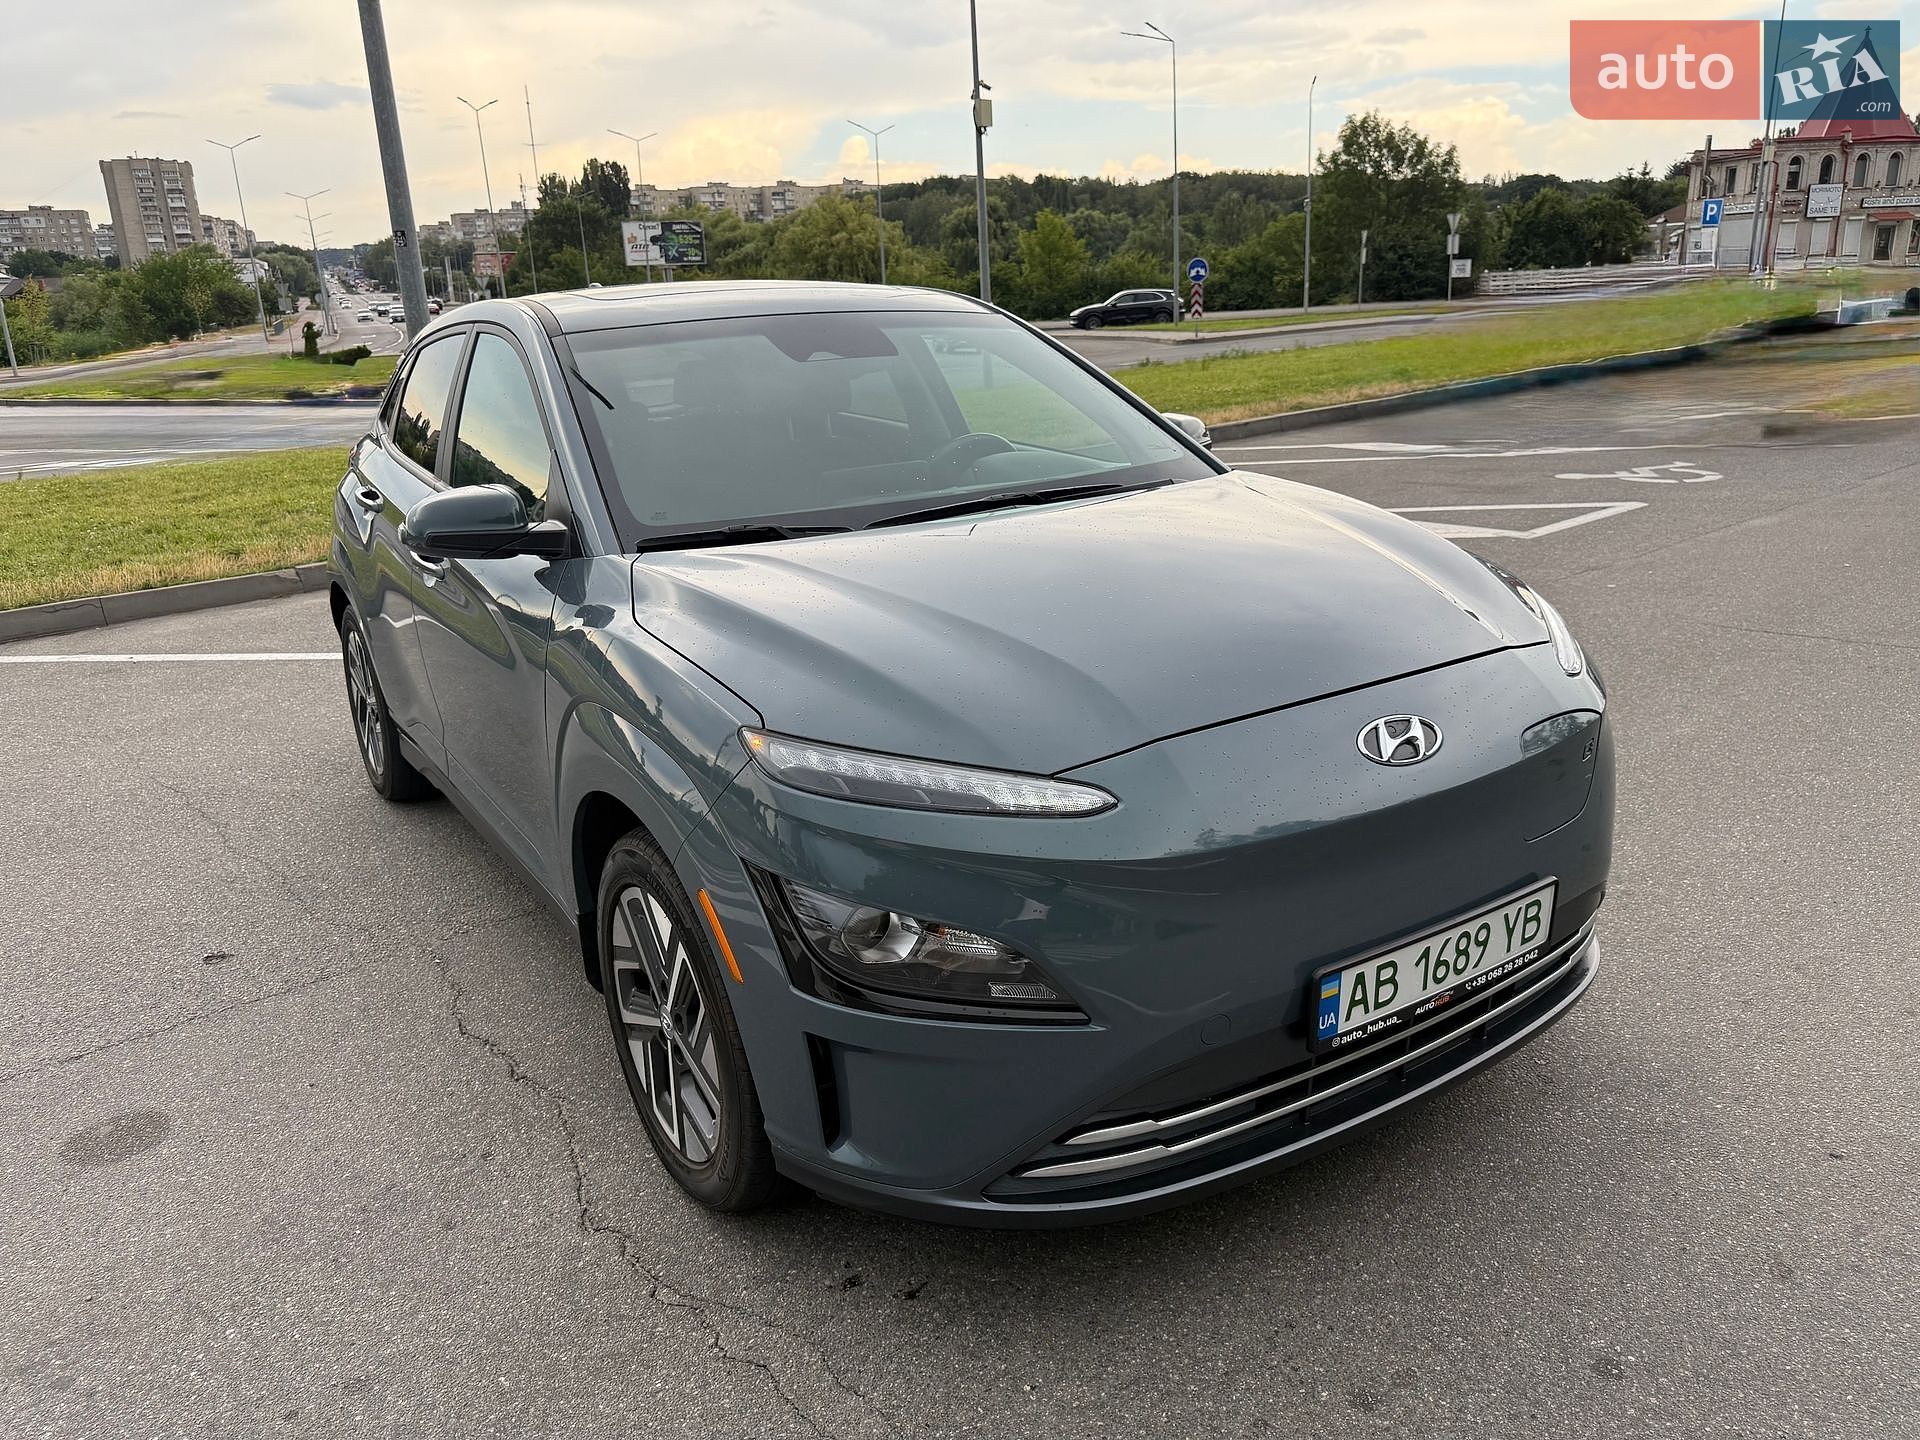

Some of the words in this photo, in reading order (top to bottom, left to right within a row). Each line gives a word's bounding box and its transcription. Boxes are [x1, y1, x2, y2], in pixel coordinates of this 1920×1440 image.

[1706, 203, 1718, 221] P
[1344, 959, 1399, 1023] AB
[1414, 922, 1491, 992] 1689
[1503, 898, 1542, 953] YB
[1487, 967, 1503, 981] 068
[1503, 962, 1514, 974] 28
[1513, 957, 1524, 969] 28
[1524, 949, 1539, 963] 042
[1319, 1011, 1337, 1031] UA
